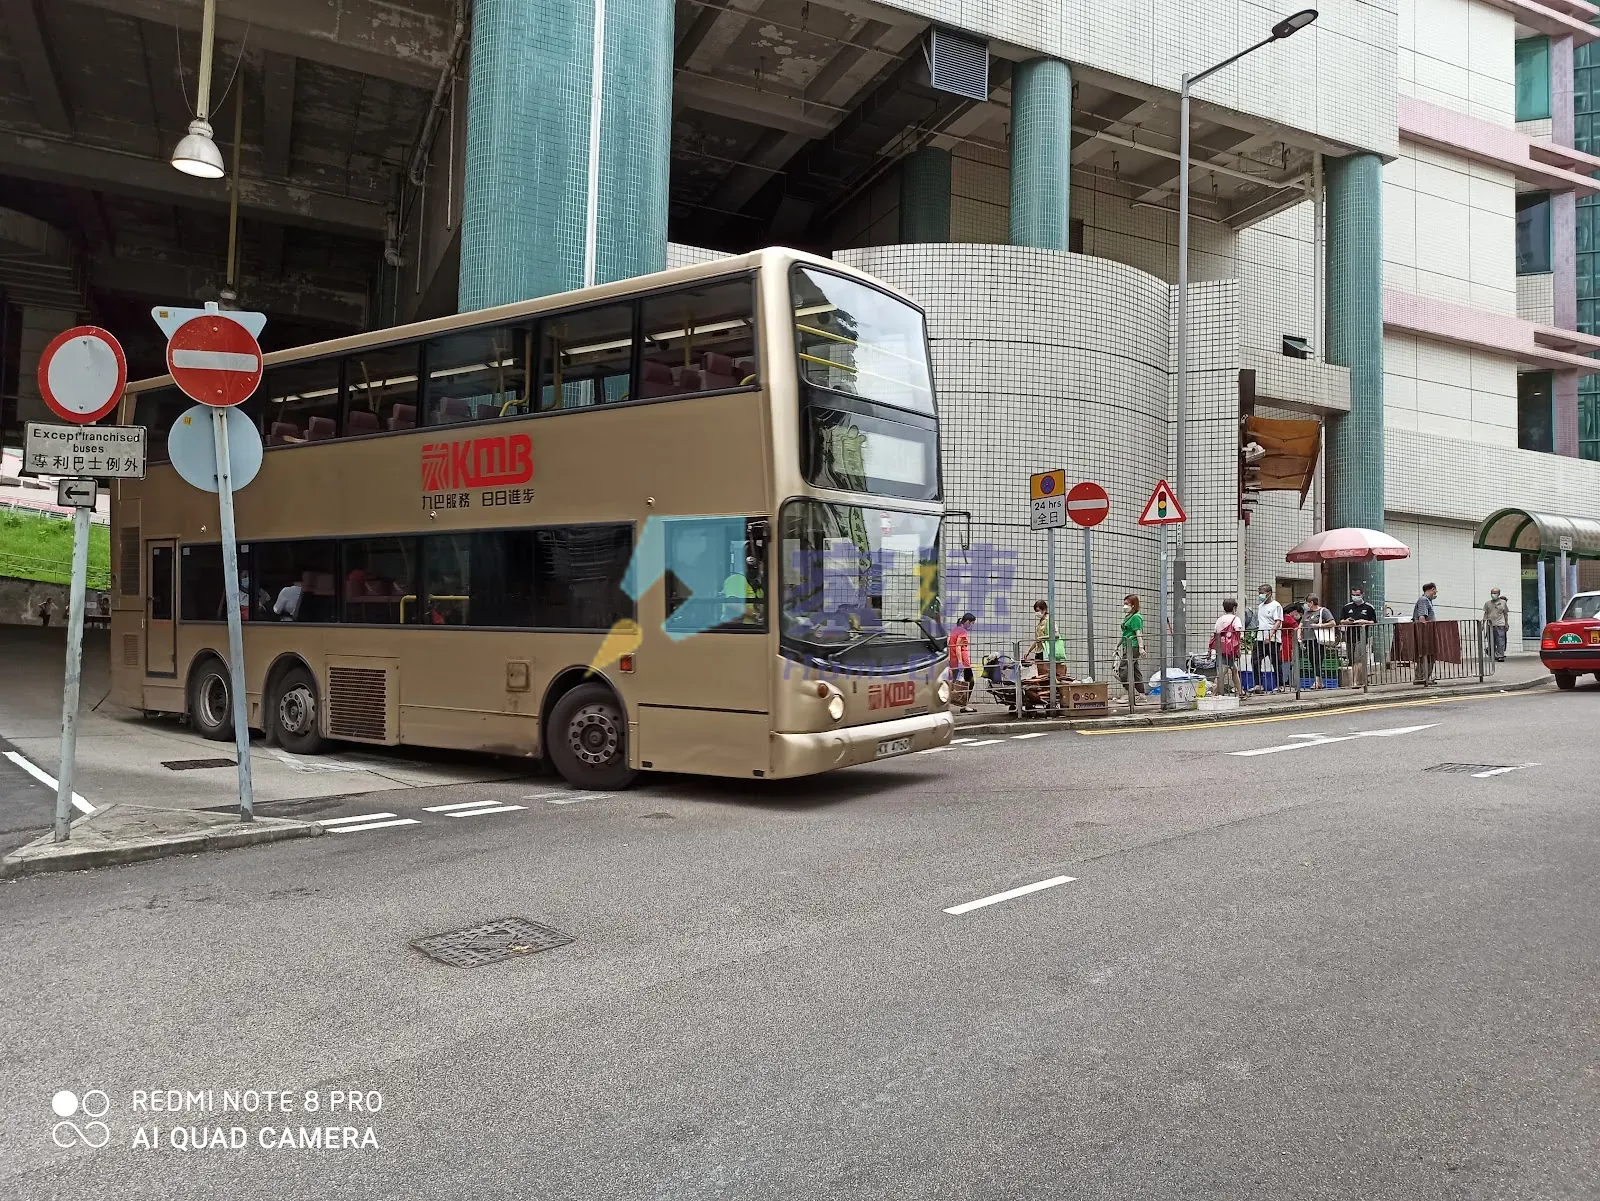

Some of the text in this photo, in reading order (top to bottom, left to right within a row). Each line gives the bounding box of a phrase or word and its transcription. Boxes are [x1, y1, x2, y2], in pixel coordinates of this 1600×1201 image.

[33, 428, 140, 443] Except franchised
[73, 444, 104, 453] buses
[31, 453, 139, 472] 專利巴士例外
[421, 488, 535, 510] 九巴服務 日日進步
[1034, 500, 1062, 511] 24 hrs
[1037, 511, 1058, 526] 全日
[883, 681, 915, 709] KMB
